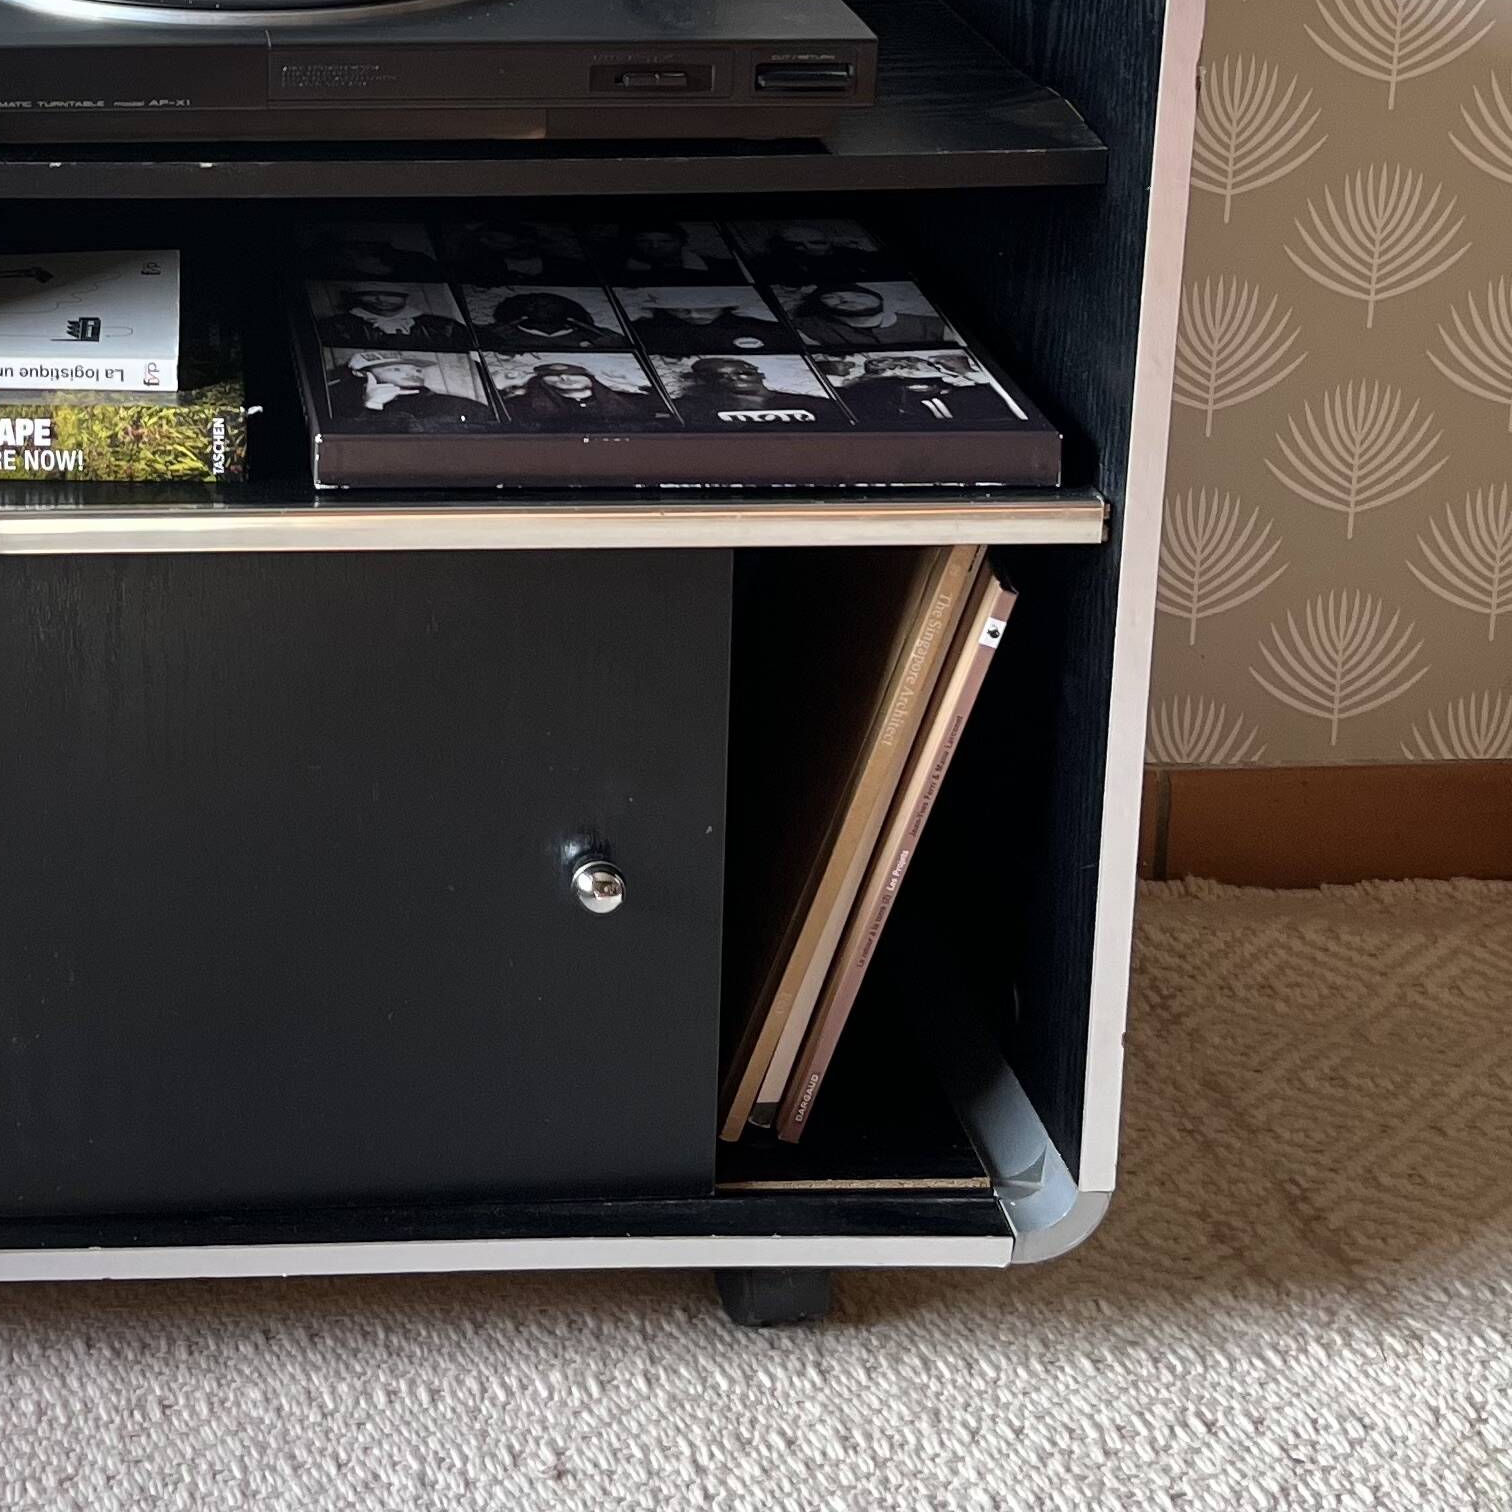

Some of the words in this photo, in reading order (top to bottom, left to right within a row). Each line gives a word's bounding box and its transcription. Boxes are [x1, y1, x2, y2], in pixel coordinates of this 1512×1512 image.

[148, 99, 191, 107] AP-X1
[19, 365, 99, 382] logistique
[105, 368, 124, 382] La
[24, 448, 85, 472] NOW!
[212, 417, 225, 475] TASCHEN
[931, 592, 952, 617] The
[905, 619, 940, 685] Singapore
[884, 687, 914, 746] Architect
[886, 876, 897, 891] Les
[893, 849, 909, 877] Projets
[795, 1073, 819, 1122] DARGAUD
